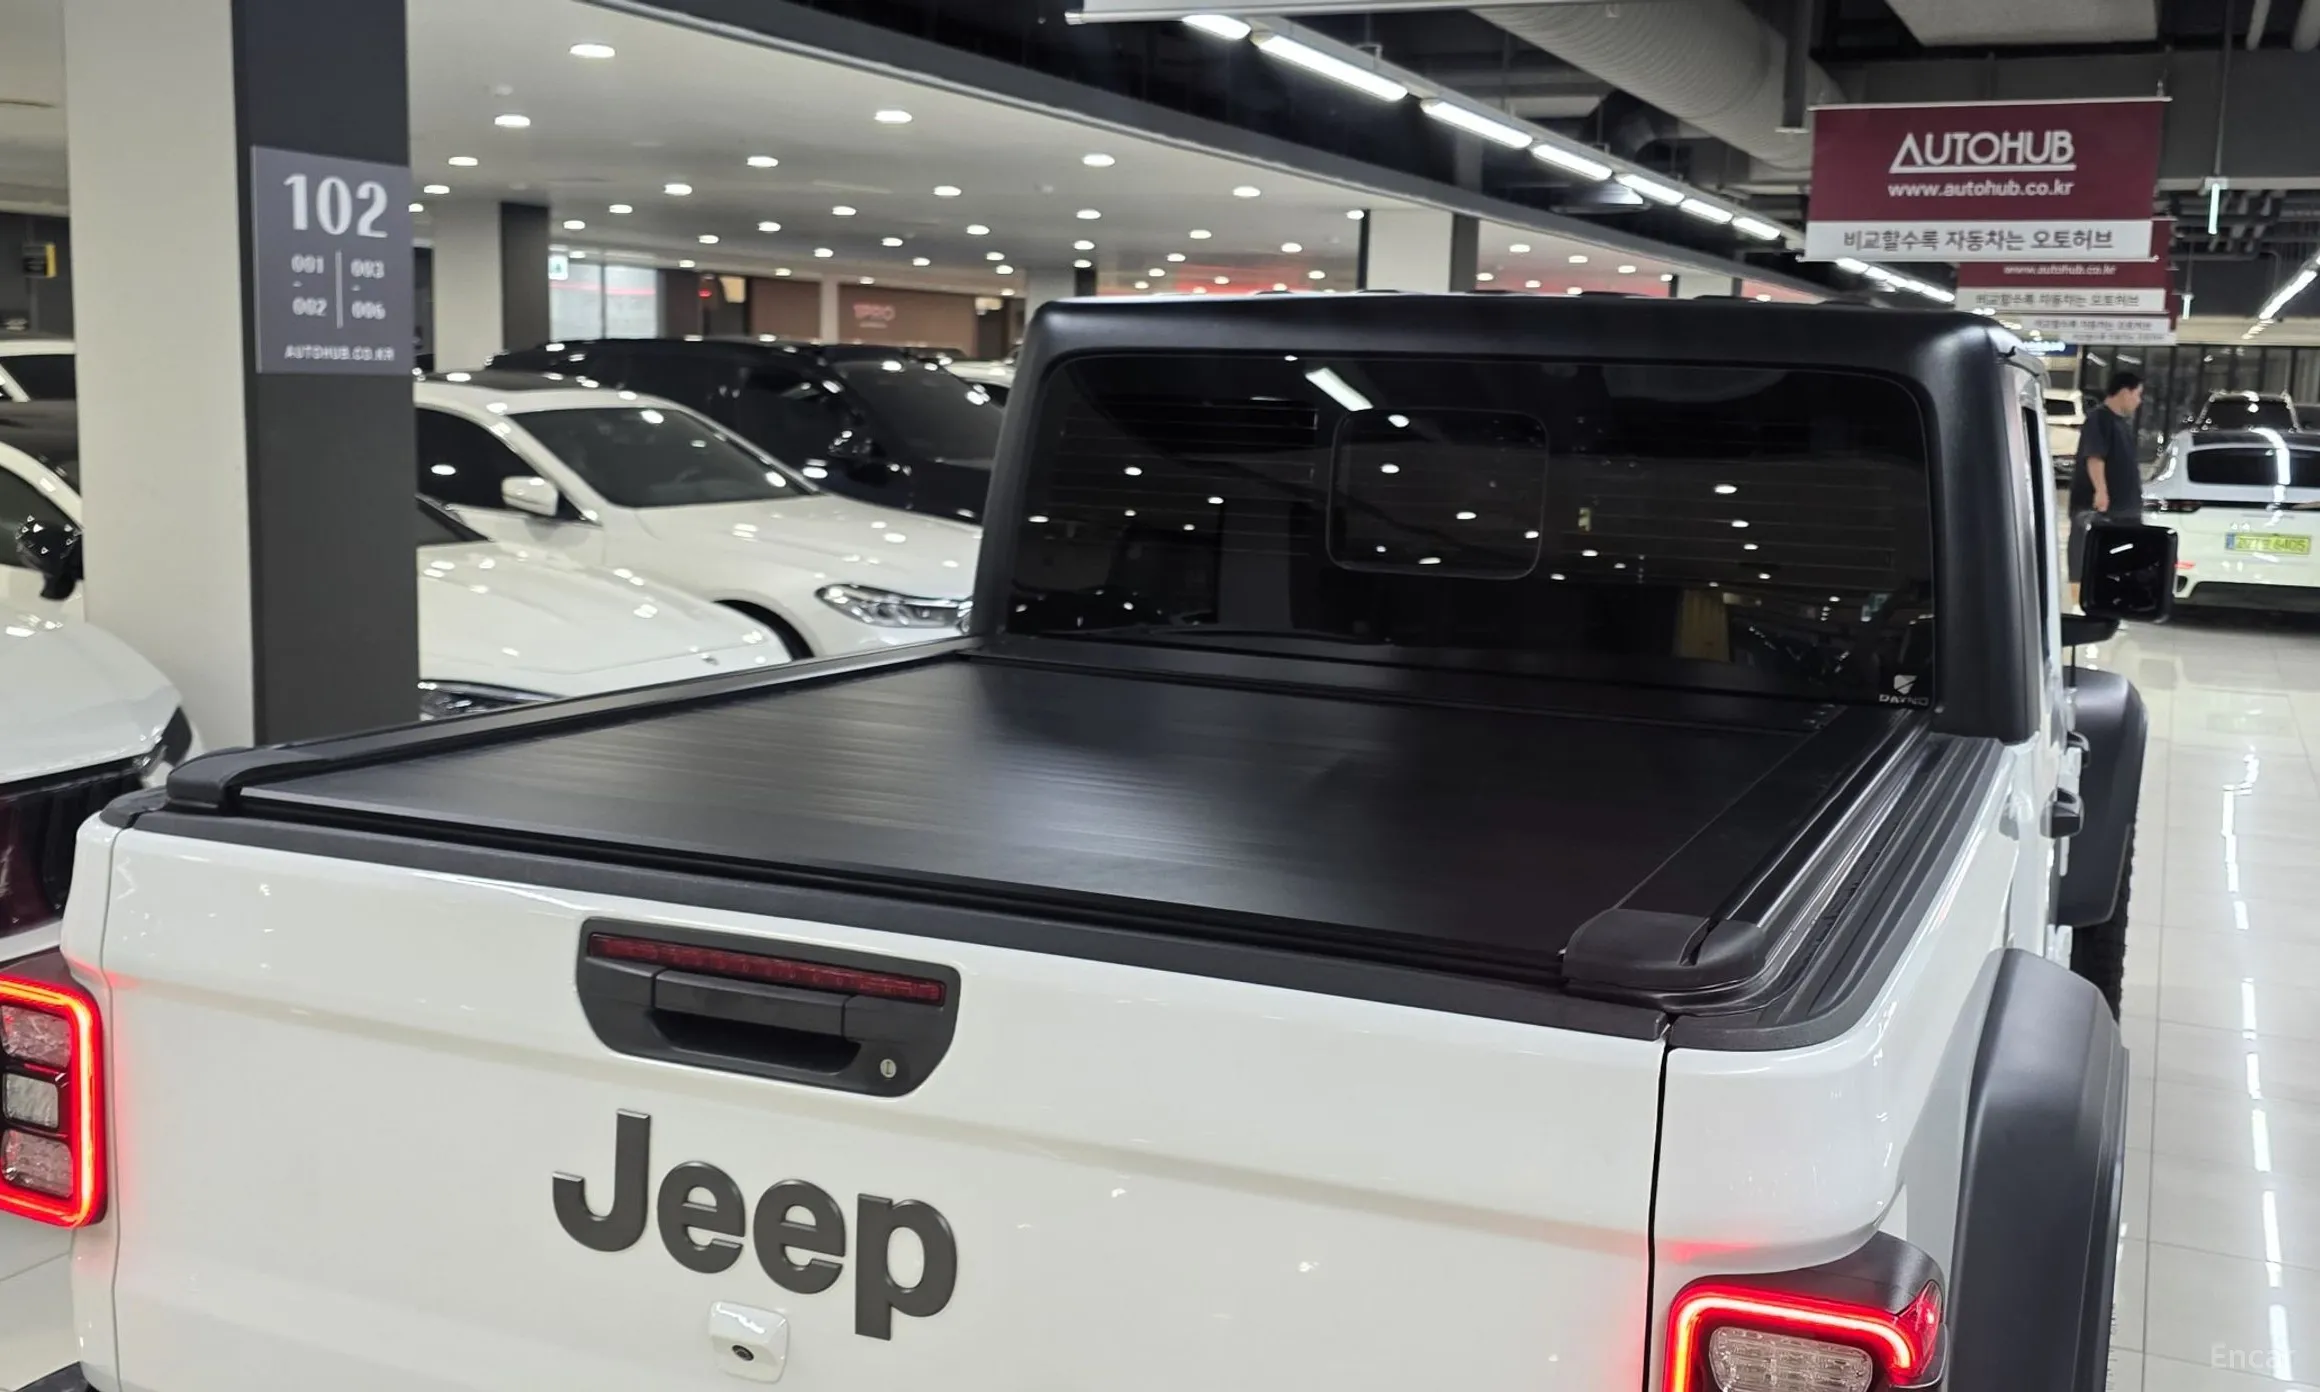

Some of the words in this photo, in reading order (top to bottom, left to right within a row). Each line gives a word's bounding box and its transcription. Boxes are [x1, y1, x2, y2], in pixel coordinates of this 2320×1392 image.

[1889, 129, 2076, 174] AUTOHUB
[1888, 178, 2074, 198] www.autohub.co.kr
[283, 173, 388, 238] 102
[1844, 230, 1939, 251] 비교할수록
[1945, 230, 2025, 251] 자동차는
[2030, 229, 2113, 250] 오토허브
[291, 254, 325, 274] 001
[292, 297, 328, 317] 002
[552, 1108, 958, 1341] Jeep
